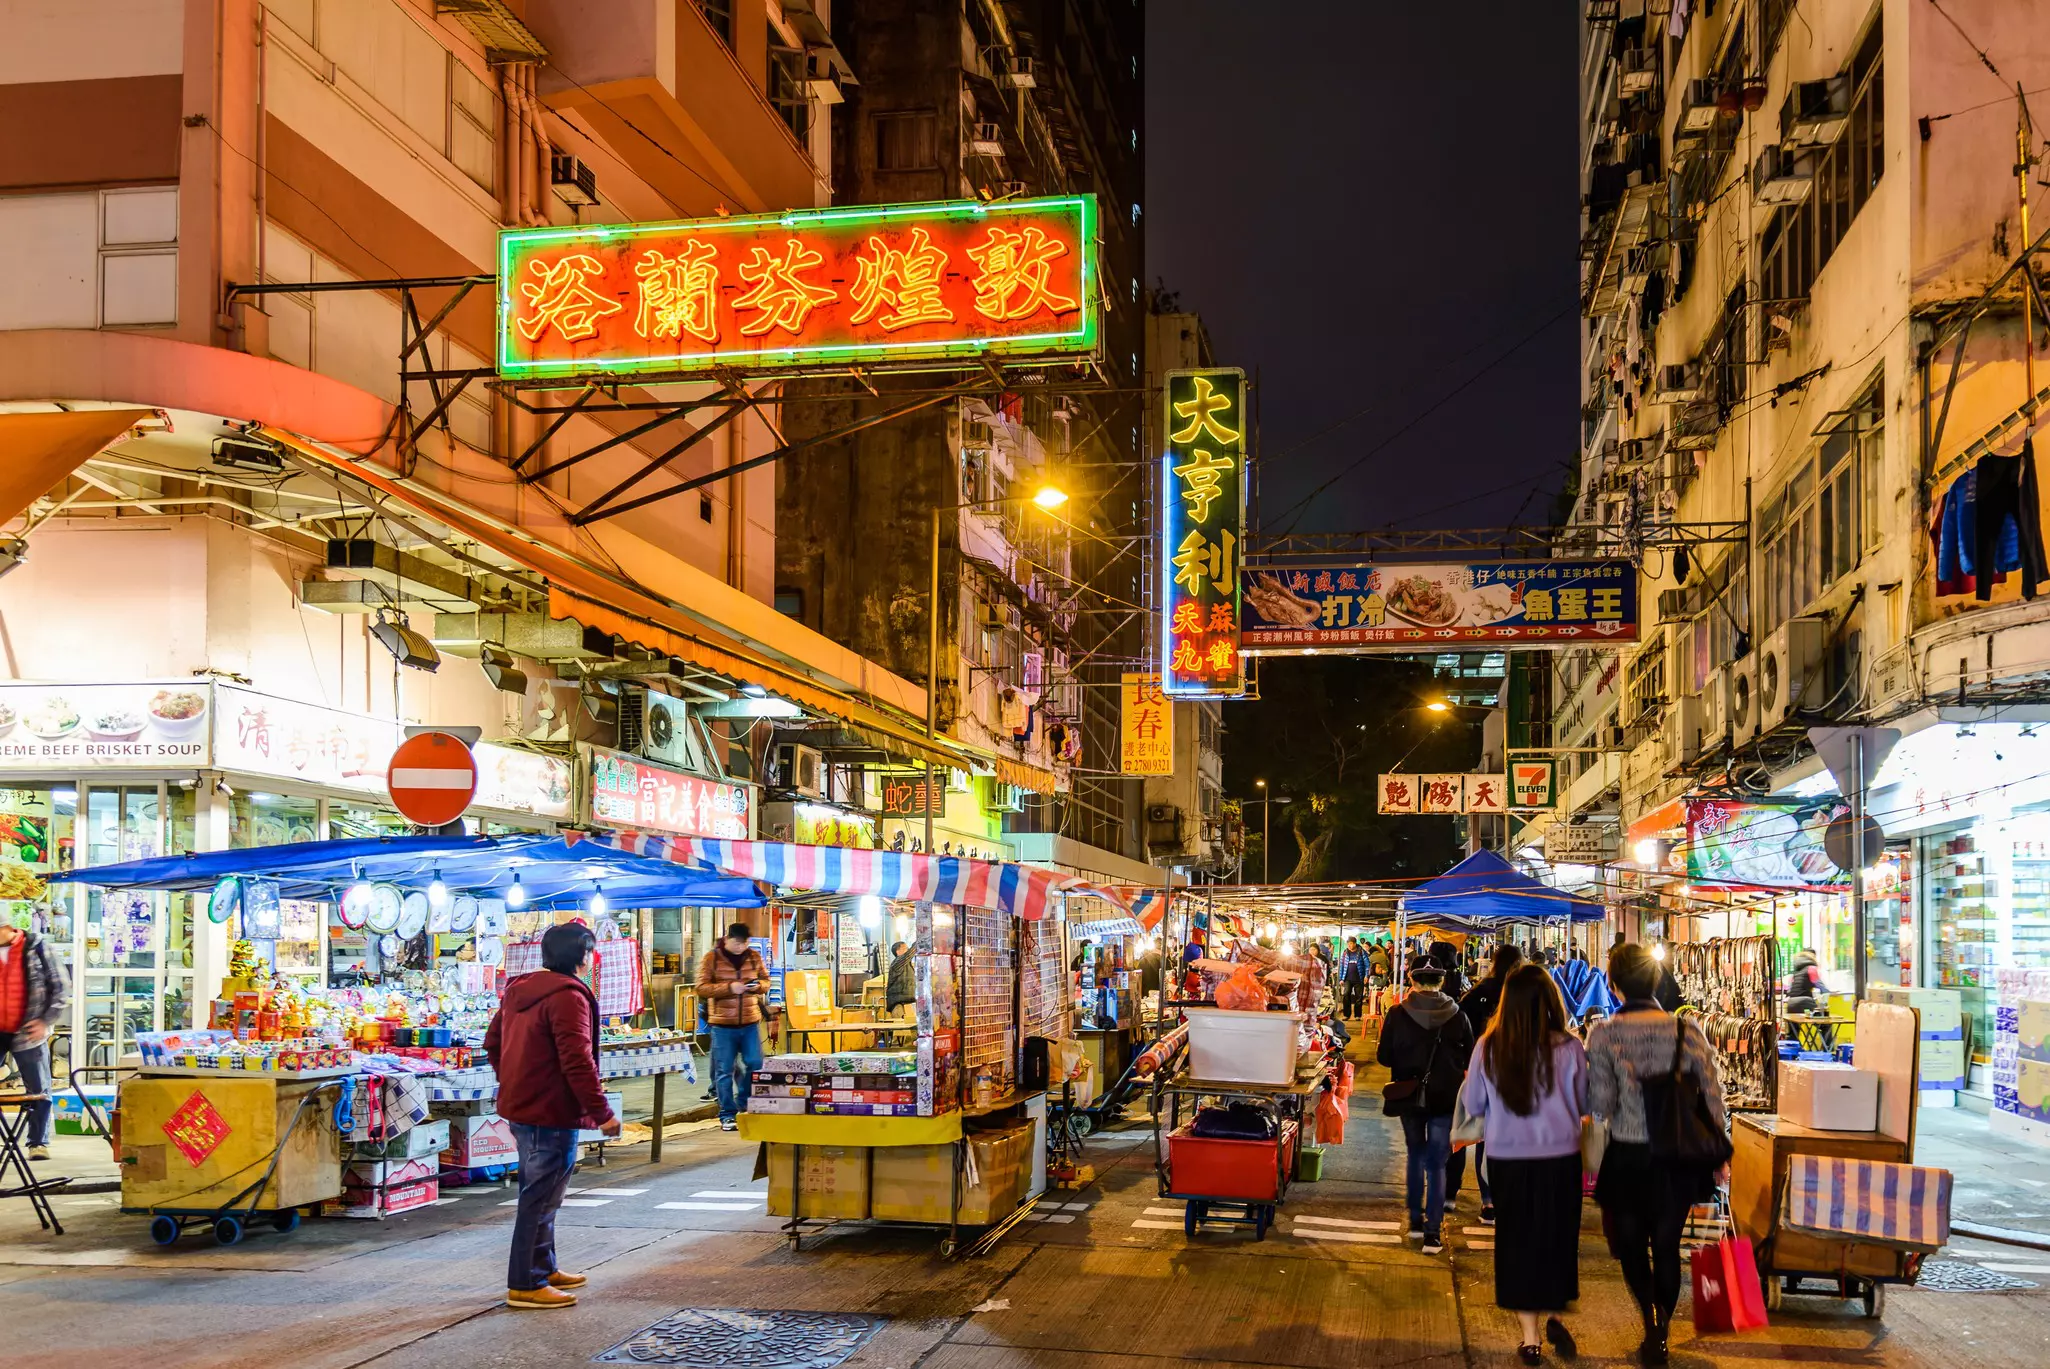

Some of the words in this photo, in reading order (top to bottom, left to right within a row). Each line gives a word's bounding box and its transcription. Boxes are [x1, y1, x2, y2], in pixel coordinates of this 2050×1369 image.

[1170, 376, 1240, 597] 大亨利
[1321, 593, 1387, 628] 打冷
[1523, 587, 1623, 621] 魚蛋王
[1132, 676, 1163, 739] 長春
[0, 745, 37, 756] EME
[42, 745, 80, 755] BEEF
[86, 744, 152, 755] BRISKET
[157, 744, 202, 755] SOUP
[1124, 741, 1171, 757] 護老中心
[640, 770, 714, 833] 富記美食
[473, 1138, 488, 1147] RED
[473, 1143, 513, 1155] MOUNTAIN
[388, 1186, 426, 1203] MOUNTAIN
